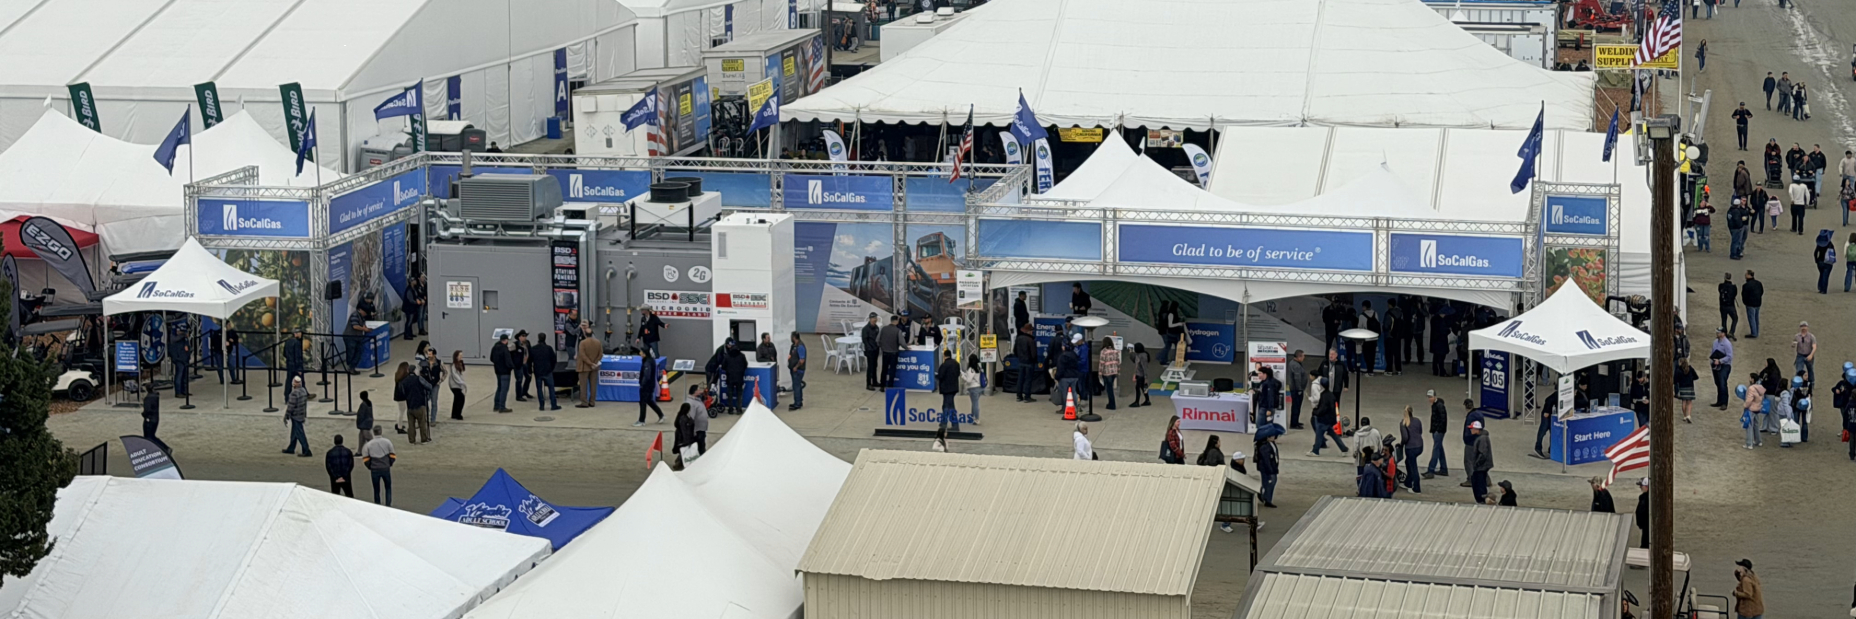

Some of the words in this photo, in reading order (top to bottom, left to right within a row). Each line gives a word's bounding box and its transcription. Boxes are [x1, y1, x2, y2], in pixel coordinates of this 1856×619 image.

[1599, 47, 1636, 56] WELDIN
[557, 80, 567, 102] A
[80, 90, 95, 118] BIRD
[204, 89, 218, 118] BIRD
[290, 90, 303, 118] BIRD
[584, 185, 625, 197] SoCalGas
[823, 191, 866, 203] SoCalGas
[238, 217, 282, 230] SoCalGas
[1564, 215, 1600, 225] SoCalGas
[26, 224, 73, 260] EZGO
[554, 246, 572, 254] BSD
[1172, 243, 1205, 257] Glad
[1209, 246, 1223, 257] to
[1226, 244, 1243, 258] be
[1246, 245, 1264, 263] of
[1438, 254, 1489, 268] SoCalGas
[693, 268, 706, 281] 2G
[152, 289, 195, 298] SoCalGas
[647, 292, 670, 300] BSD
[1511, 330, 1547, 346] SoCalGas
[1597, 335, 1638, 347] SoCalGas
[920, 363, 930, 372] dig
[908, 407, 974, 424] SoCalGas
[1182, 407, 1236, 423] Rinnai
[1574, 433, 1592, 442] Start
[1593, 430, 1611, 439] Here
[130, 448, 147, 459] ADULT
[131, 451, 162, 465] EDUCATION
[134, 455, 169, 472] CONSORTIUM
